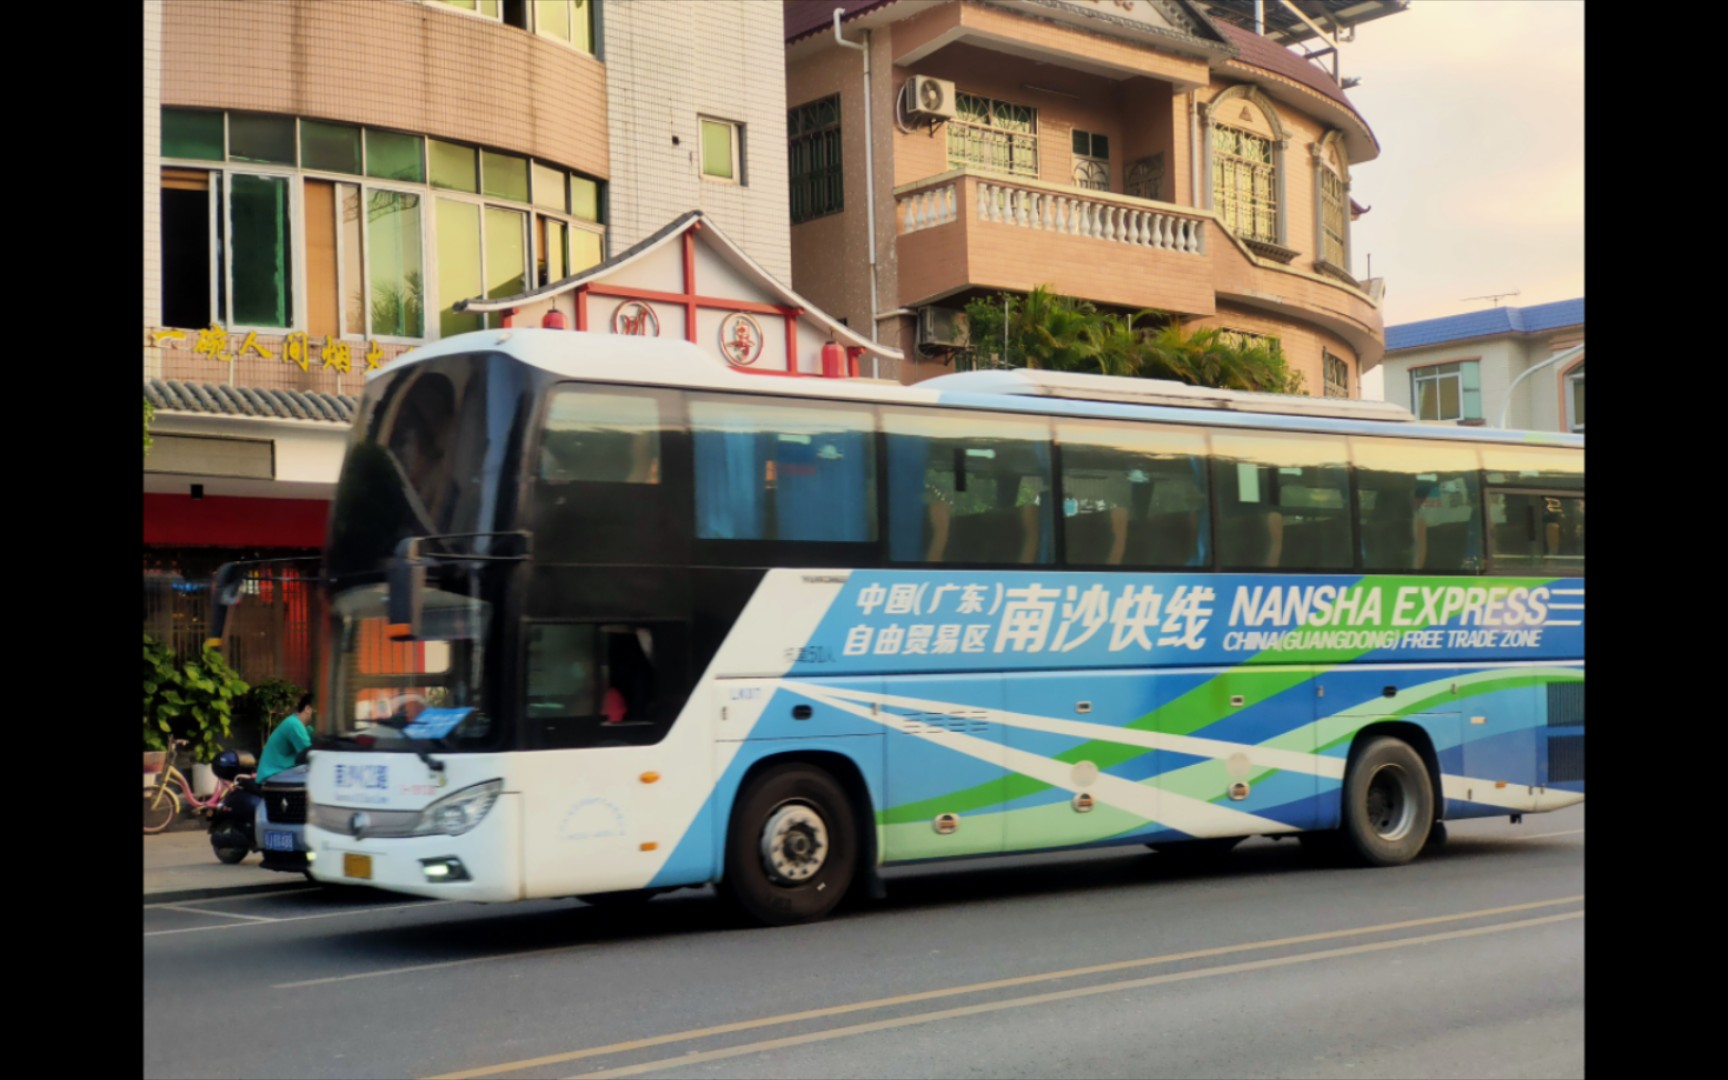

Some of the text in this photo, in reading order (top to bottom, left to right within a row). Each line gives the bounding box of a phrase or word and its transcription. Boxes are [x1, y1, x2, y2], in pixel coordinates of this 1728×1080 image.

[152, 323, 416, 376] 一碗人间烟火
[855, 582, 1004, 616] 中国(广东)
[1228, 585, 1550, 627] NANSHA EXPRESS
[993, 583, 1216, 654] 南沙快线
[842, 623, 991, 656] 自由贸易区
[1222, 628, 1543, 652] CHINA(GUANGDONG) FREE TRADE ZONE
